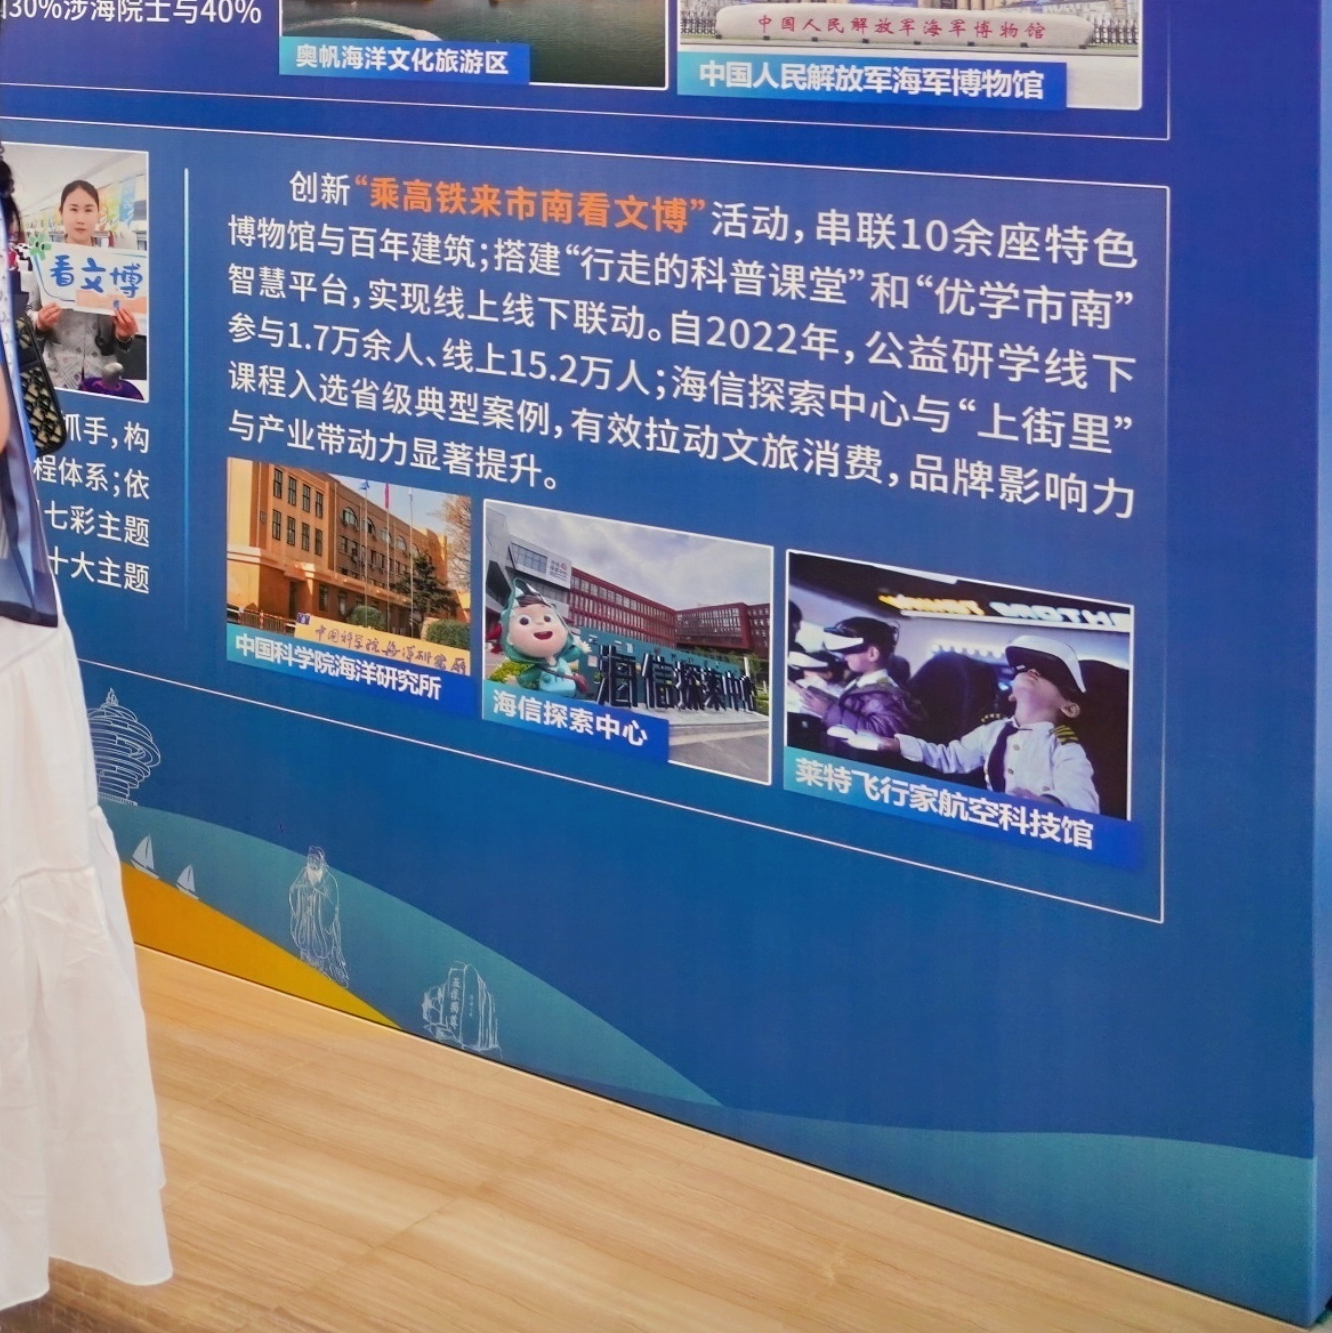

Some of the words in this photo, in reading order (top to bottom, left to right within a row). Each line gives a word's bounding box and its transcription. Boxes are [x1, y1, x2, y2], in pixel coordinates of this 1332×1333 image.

[756, 14, 1047, 41] 中国人民解放军海军博物馆
[296, 44, 509, 75] 奥帆海洋文化旅游区
[698, 59, 1045, 101] 中国人民解放军海军博物馆
[289, 169, 1139, 269] 创新“乘高铁来市南看文博”活动，串联10余座特色
[50, 254, 144, 300] 看文博
[227, 262, 1137, 395] 智慧平台，实现线上线下联动。自2022年，公益研学线下
[228, 360, 1135, 520] 课程入选省级典型案例，有效拉动文旅消费，品牌影响力
[228, 409, 558, 491] 与产业带动力显著提升。
[36, 500, 150, 548] 七彩主题
[234, 632, 442, 701] 中国科学院海洋研究所
[492, 689, 648, 747] 海信探索中心
[794, 756, 1095, 851] 莱特飞行家航空科技馆
